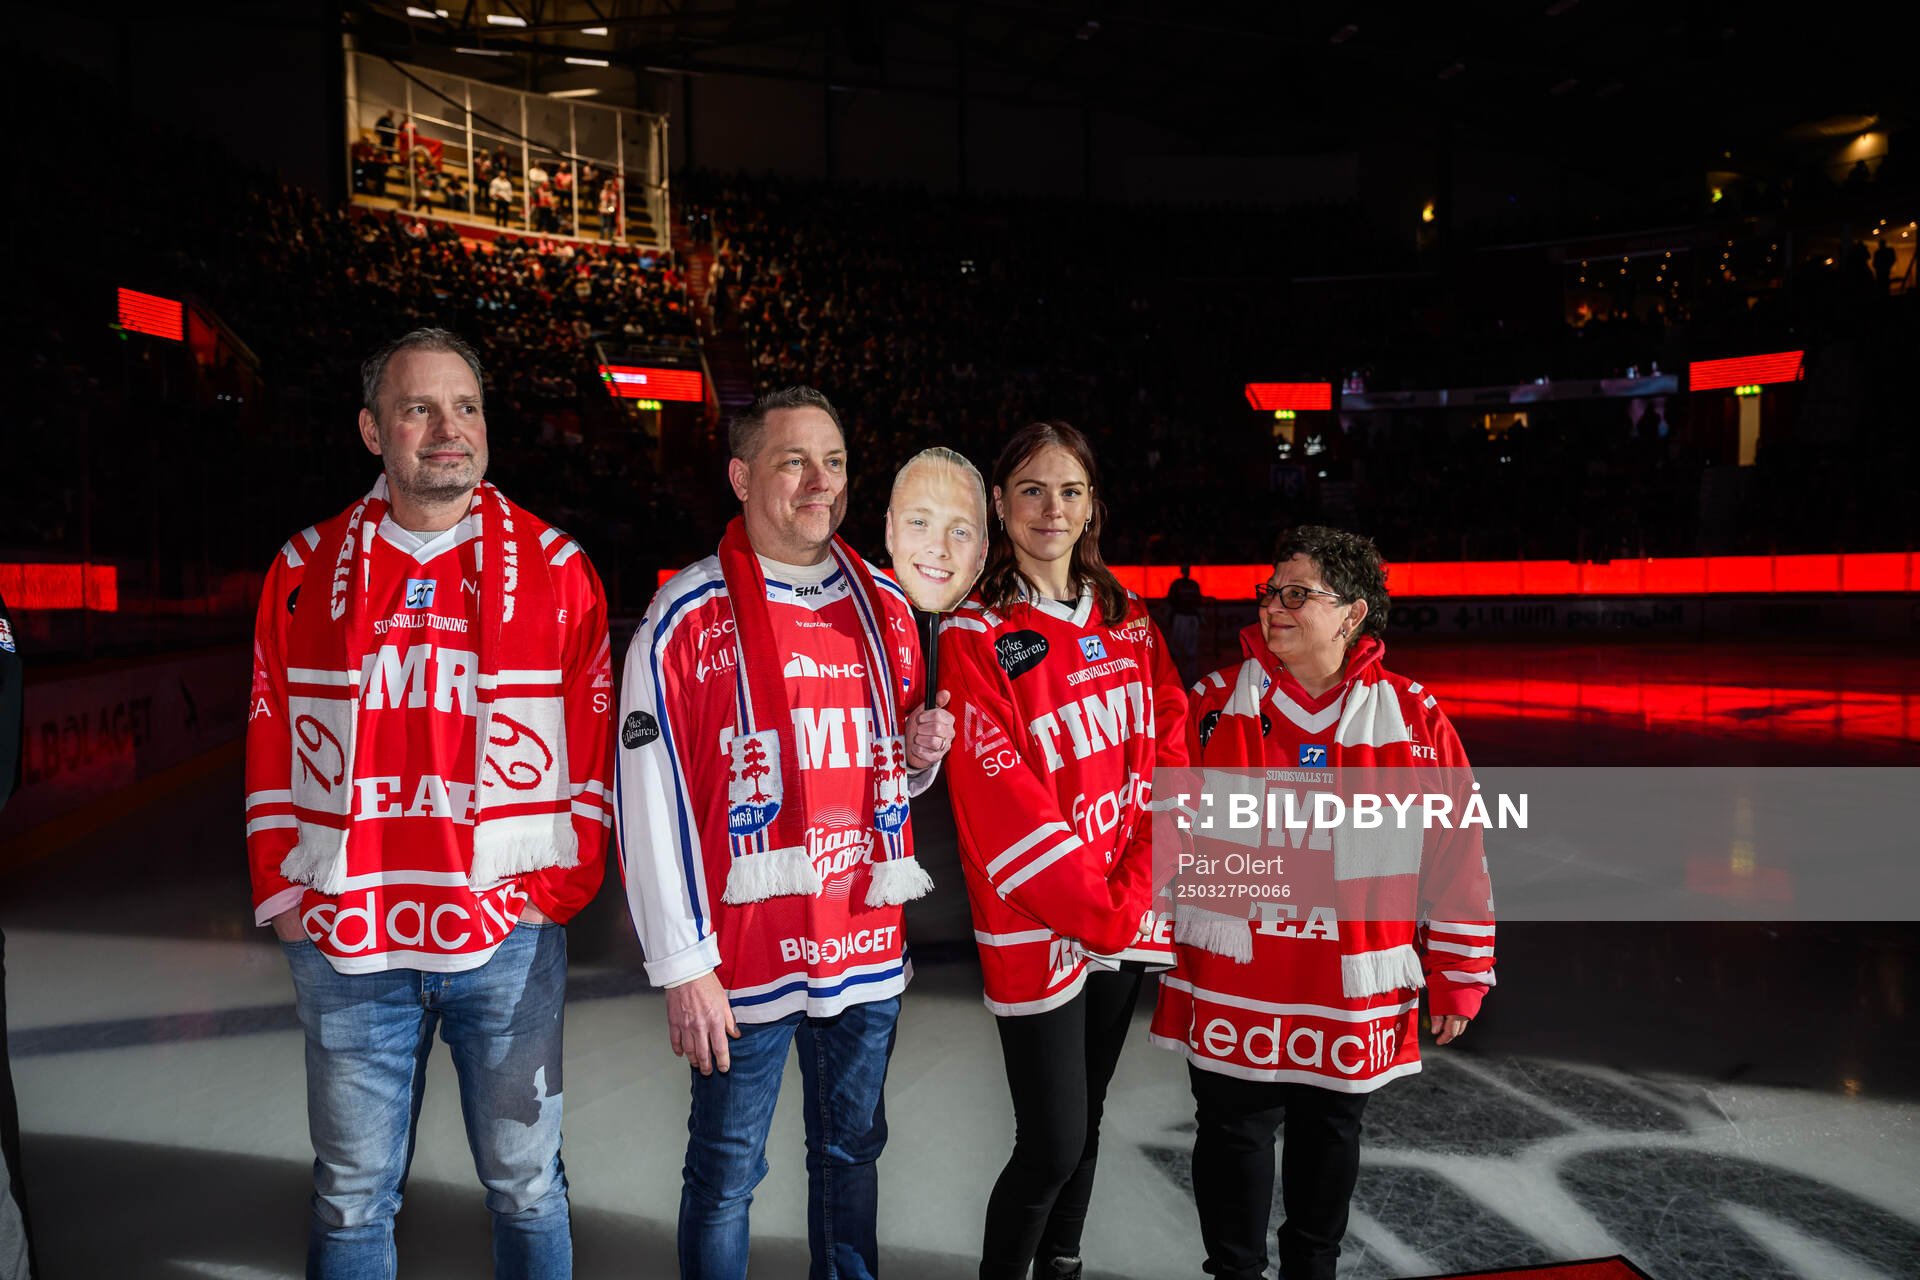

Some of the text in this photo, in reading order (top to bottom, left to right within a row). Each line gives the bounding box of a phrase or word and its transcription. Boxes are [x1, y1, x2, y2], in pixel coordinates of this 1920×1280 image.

[795, 585, 822, 597] SHL
[426, 613, 469, 633] TIDNING
[819, 663, 865, 678] NHC
[1266, 770, 1321, 784] SUNDSVALLS
